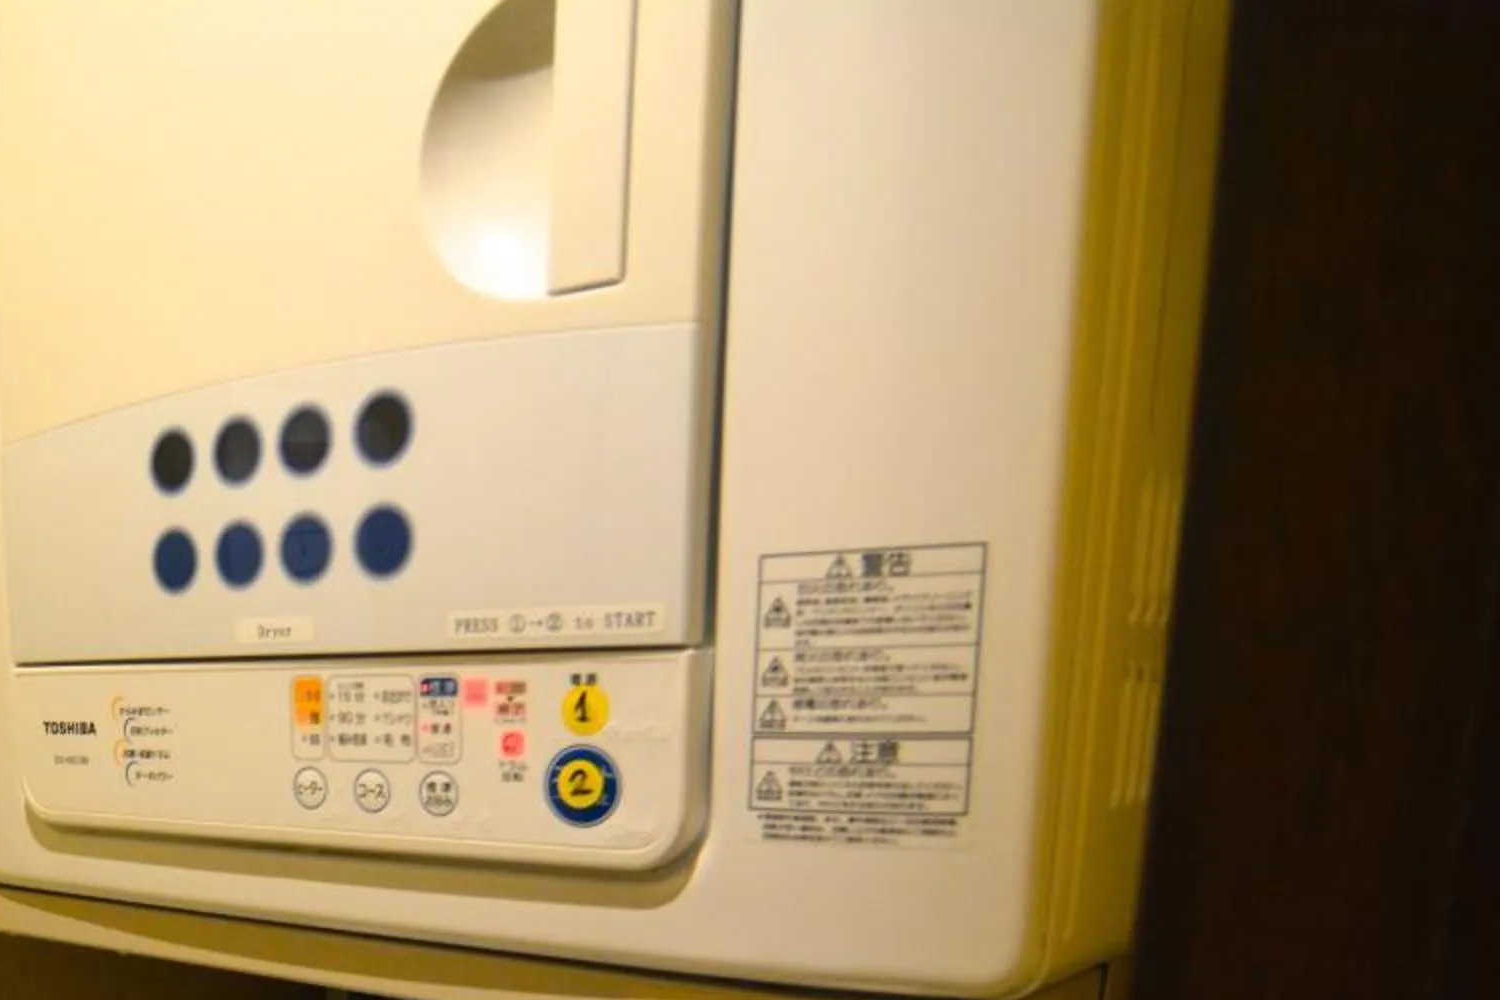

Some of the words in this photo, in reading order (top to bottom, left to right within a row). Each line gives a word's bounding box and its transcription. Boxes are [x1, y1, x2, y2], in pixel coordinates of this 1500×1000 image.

[257, 624, 293, 640] Dryer
[454, 617, 500, 635] PRESS
[574, 615, 594, 631] to
[603, 611, 657, 629] START
[574, 690, 592, 723] 1
[42, 721, 97, 735] TOSHIBA
[568, 768, 594, 797] 2
